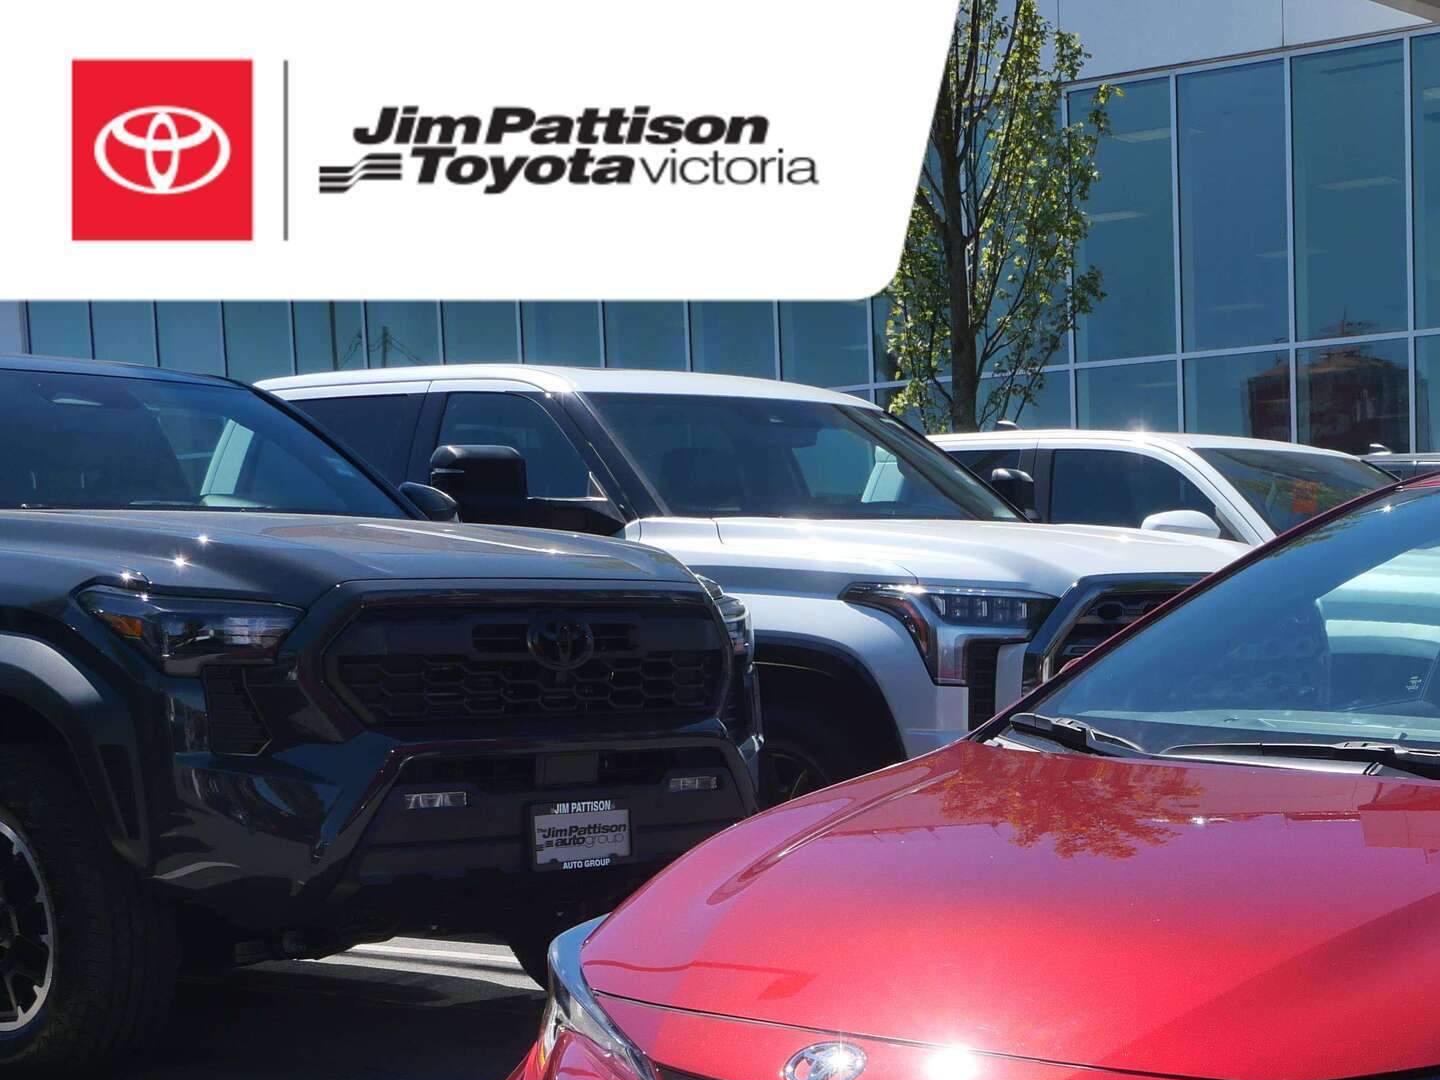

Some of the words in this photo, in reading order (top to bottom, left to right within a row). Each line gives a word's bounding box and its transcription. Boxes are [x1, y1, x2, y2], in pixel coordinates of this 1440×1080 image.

[554, 803, 569, 814] JIM
[571, 800, 611, 813] PATTISON
[543, 827, 568, 838] Jim
[568, 823, 626, 837] Pattison
[563, 861, 583, 870] AUTO
[584, 858, 611, 868] GROUP
